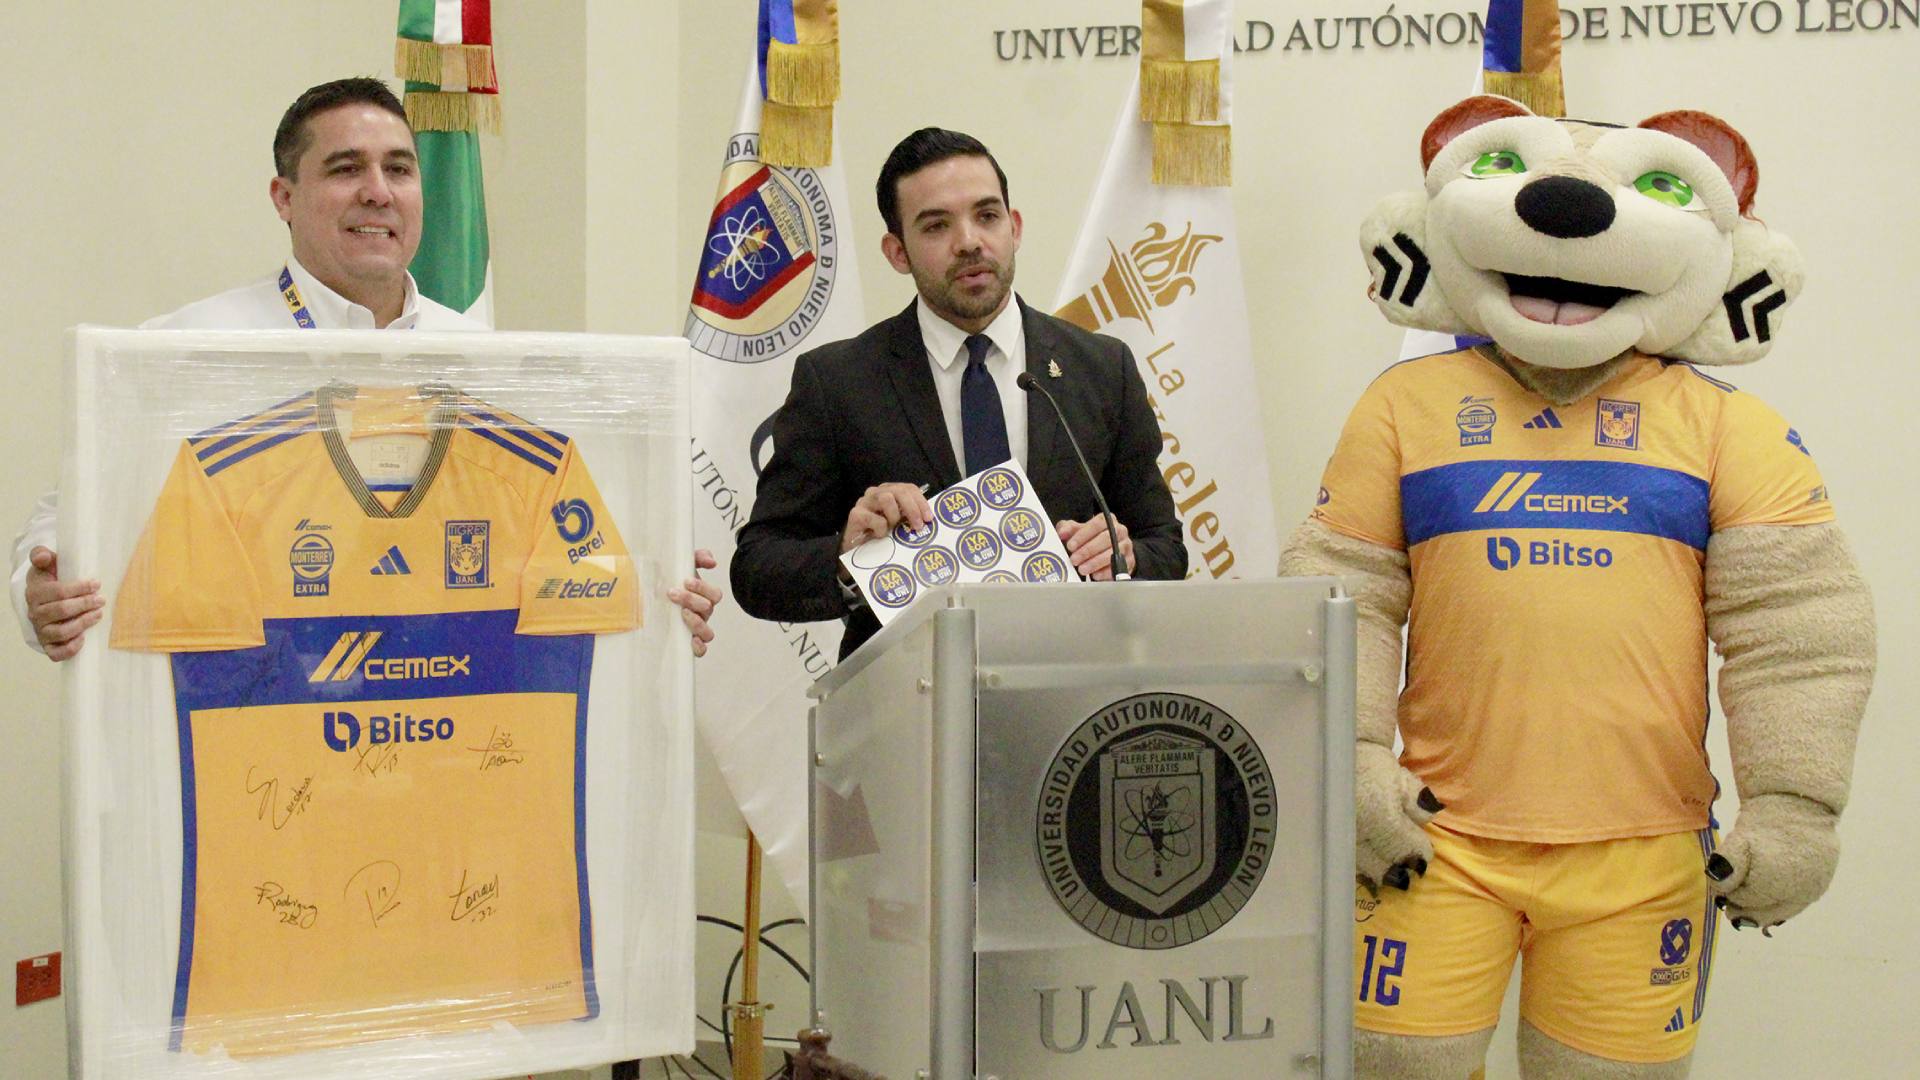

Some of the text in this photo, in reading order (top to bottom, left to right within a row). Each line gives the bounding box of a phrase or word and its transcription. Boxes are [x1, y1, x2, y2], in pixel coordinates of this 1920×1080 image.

[1620, 1, 1783, 38] NUEVO
[789, 276, 830, 338] NUEVO
[743, 331, 786, 357] LEON
[1146, 341, 1185, 397] La
[1462, 435, 1489, 444] EXTRA
[1524, 494, 1629, 515] CEMEX
[449, 525, 486, 535] TIGRES
[291, 550, 333, 563] MONTERREY
[567, 531, 605, 565] Berel
[1529, 539, 1613, 568] Bitso
[295, 584, 327, 593] EXTRA
[455, 575, 477, 585] UANL
[558, 577, 618, 599] telcel
[364, 655, 470, 680] CEMEX
[369, 713, 454, 745] Bitso
[1092, 700, 1213, 742] AUTONOMA
[1120, 751, 1195, 764] ALERE FLAMMAM
[1134, 763, 1179, 774] VERITATIS
[1233, 742, 1270, 817] NUEVO
[1043, 739, 1089, 899] UNIVERSIDAD
[1238, 829, 1270, 887] LEON
[1359, 934, 1407, 1006] 12
[1033, 974, 1275, 1054] UANL
